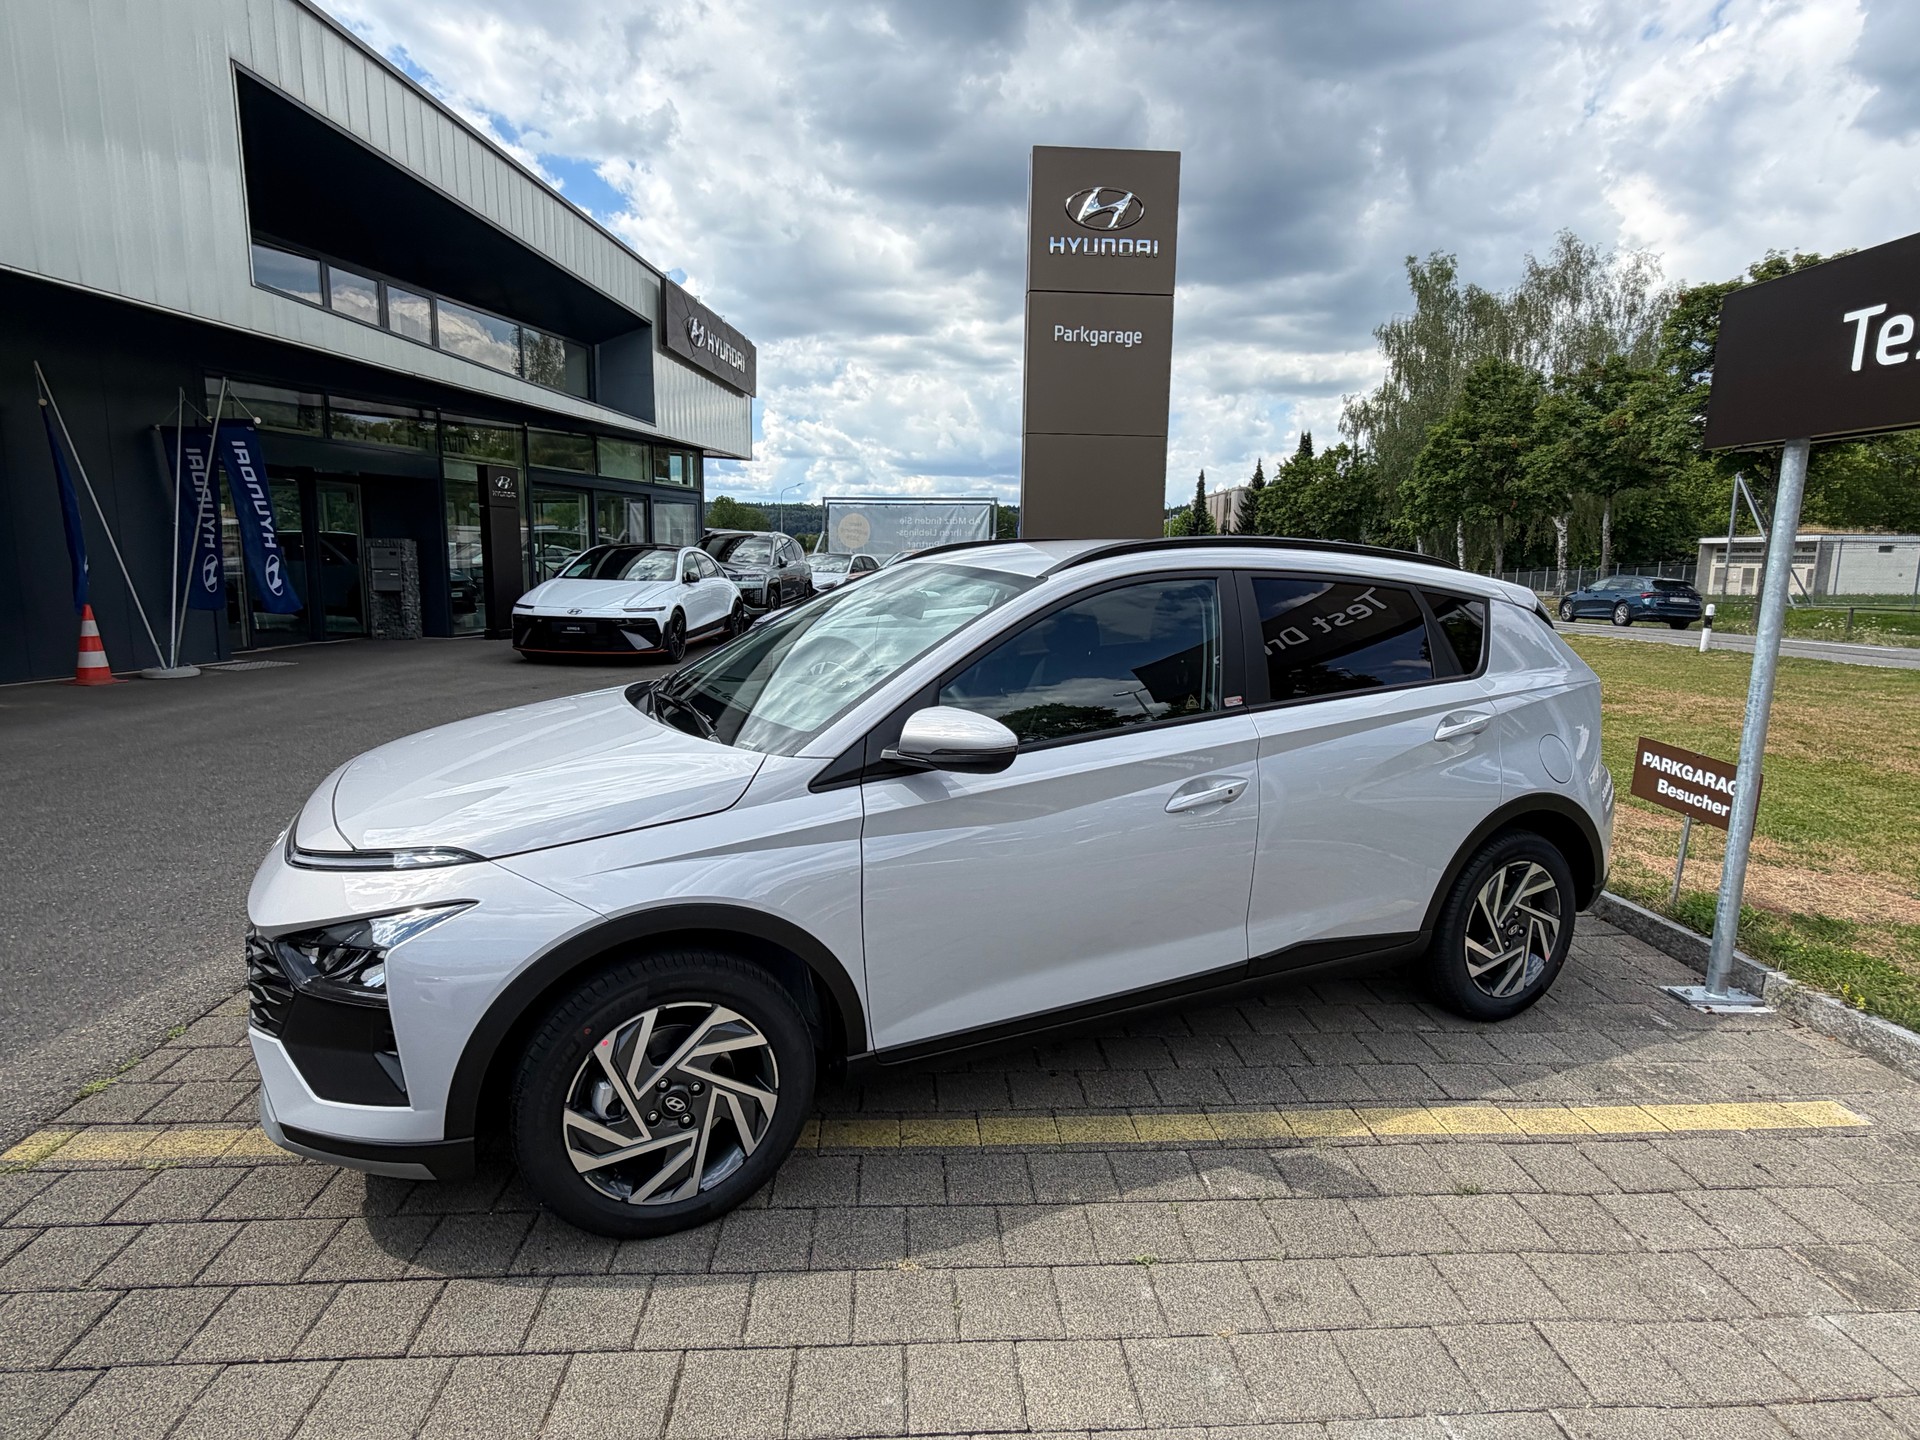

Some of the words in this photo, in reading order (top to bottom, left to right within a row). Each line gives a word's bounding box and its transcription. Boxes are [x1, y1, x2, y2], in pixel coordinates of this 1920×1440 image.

[1049, 236, 1159, 258] HYUNDAI
[707, 330, 746, 373] HYUNDAI
[1054, 325, 1143, 348] Parkgarage
[1843, 303, 1920, 372] Te
[185, 448, 216, 549] HYUNDAI
[231, 441, 278, 549] HYUNDAI
[1657, 778, 1731, 817] Besucher
